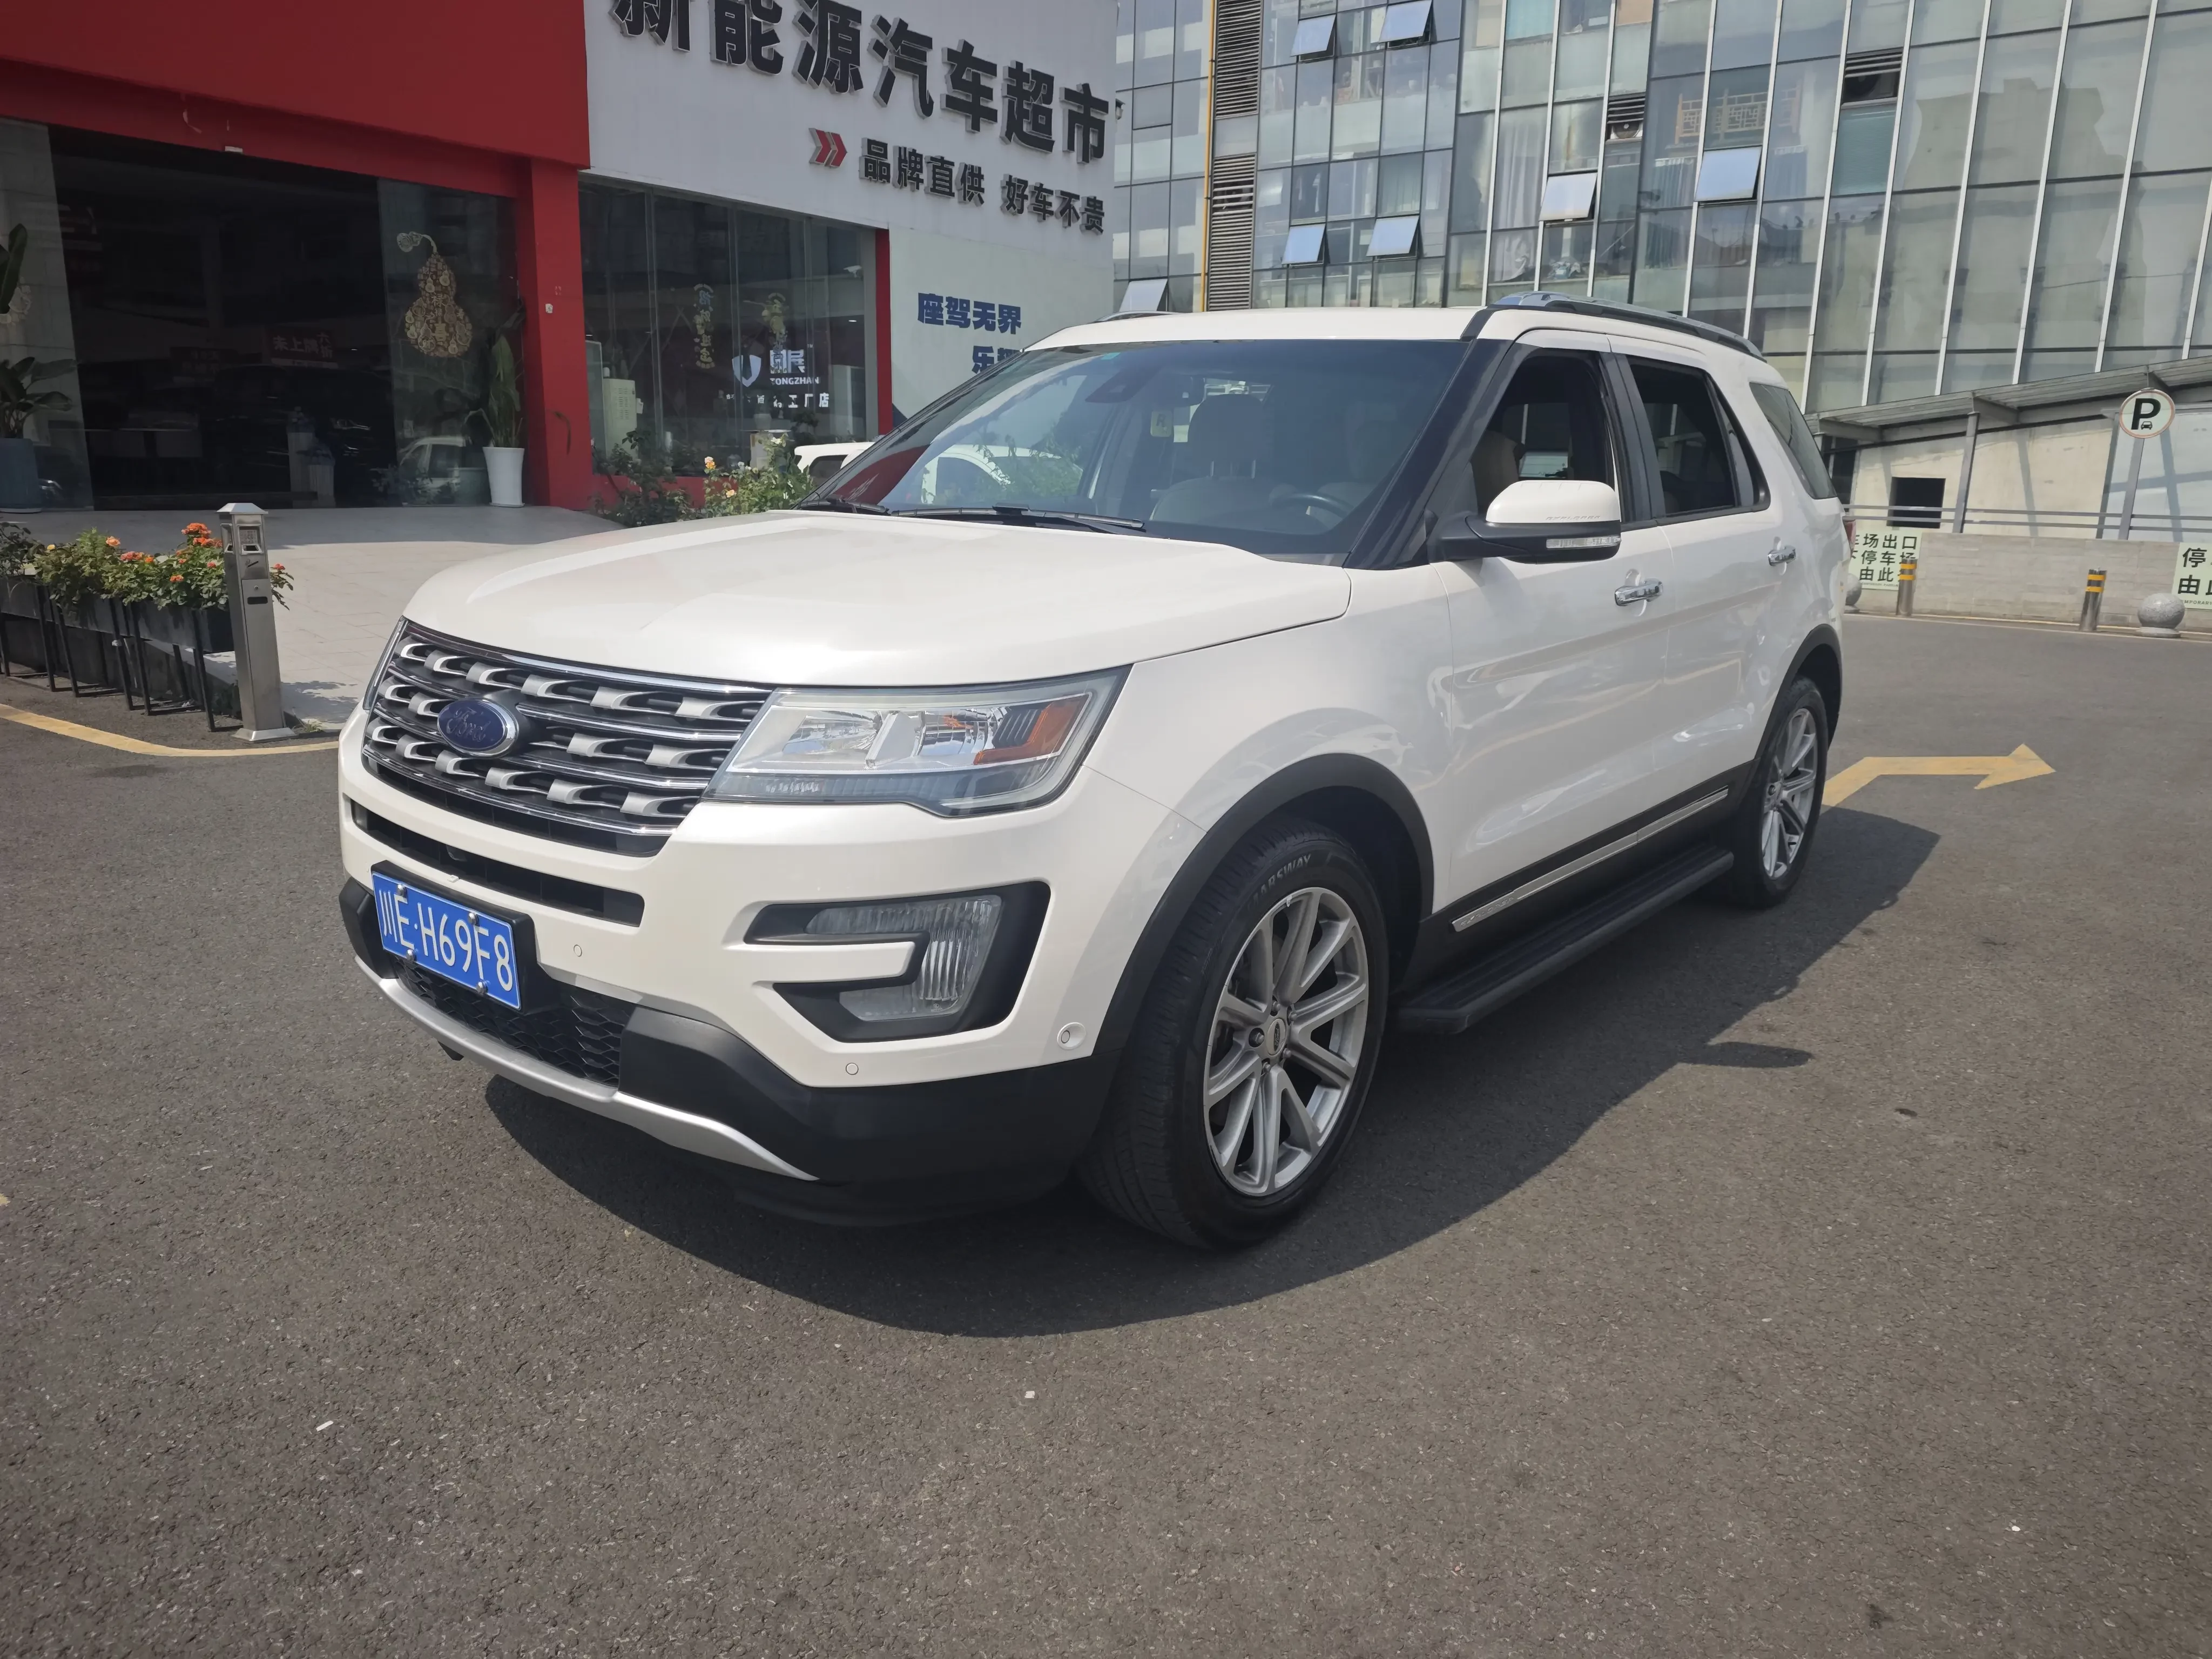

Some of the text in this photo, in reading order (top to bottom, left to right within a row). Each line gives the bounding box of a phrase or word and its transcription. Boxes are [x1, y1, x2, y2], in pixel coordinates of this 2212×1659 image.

[860, 137, 1105, 235] 品牌直供 好车不贵
[918, 293, 1021, 334] 座驾无界
[2131, 398, 2161, 430] P
[1859, 566, 1901, 582] 由此
[2182, 547, 2207, 568] 停
[446, 706, 491, 743] Ford
